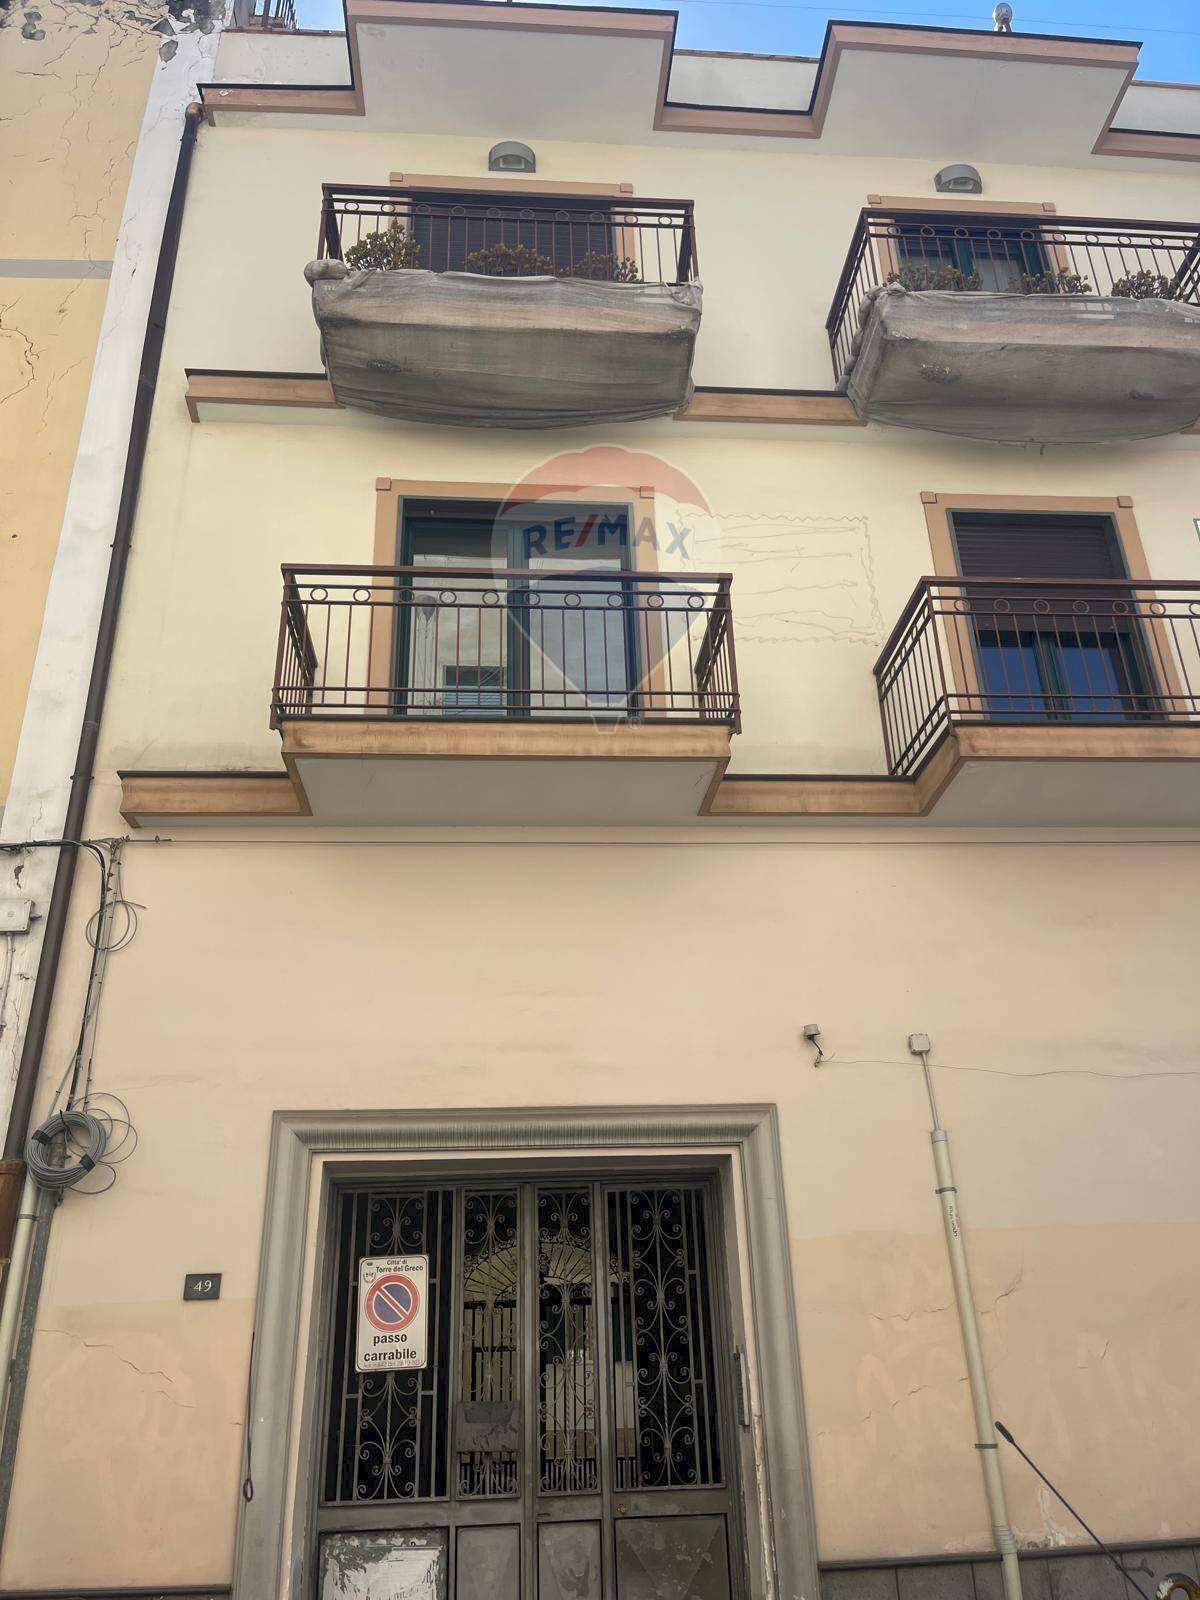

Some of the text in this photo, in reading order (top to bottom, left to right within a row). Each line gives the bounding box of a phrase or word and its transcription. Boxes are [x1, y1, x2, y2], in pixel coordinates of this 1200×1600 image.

[194, 1280, 212, 1292] 49
[373, 1334, 408, 1346] passo
[363, 1348, 417, 1362] carrabile
